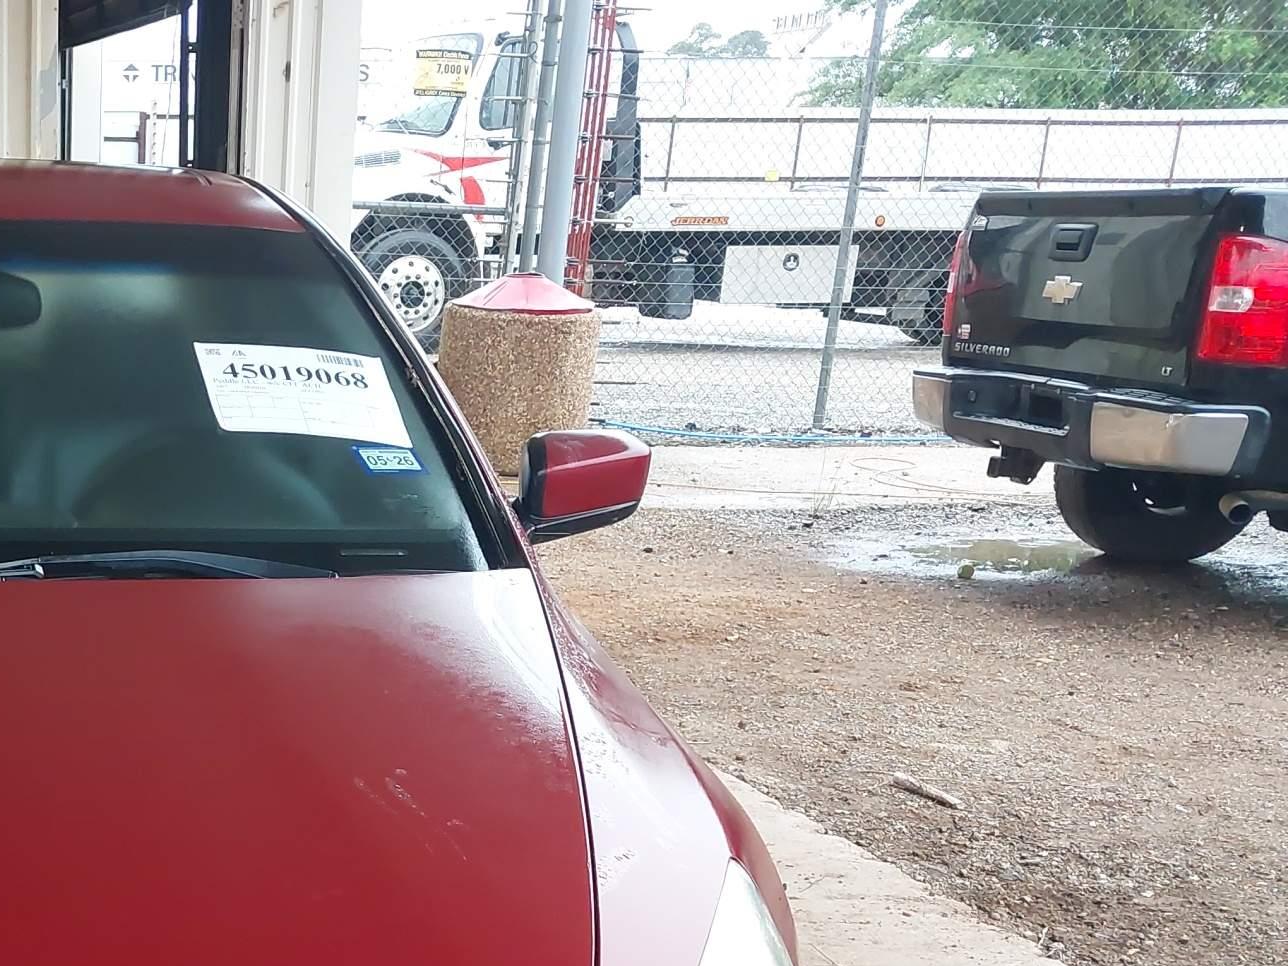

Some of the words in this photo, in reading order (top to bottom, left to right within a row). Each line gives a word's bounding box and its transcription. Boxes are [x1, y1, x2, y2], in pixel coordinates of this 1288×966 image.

[151, 64, 177, 82] TR
[436, 63, 462, 75] 7,000
[463, 64, 470, 75] V
[954, 341, 1011, 357] SILVERADO
[222, 362, 369, 390] 45019068
[1161, 366, 1173, 377] LT
